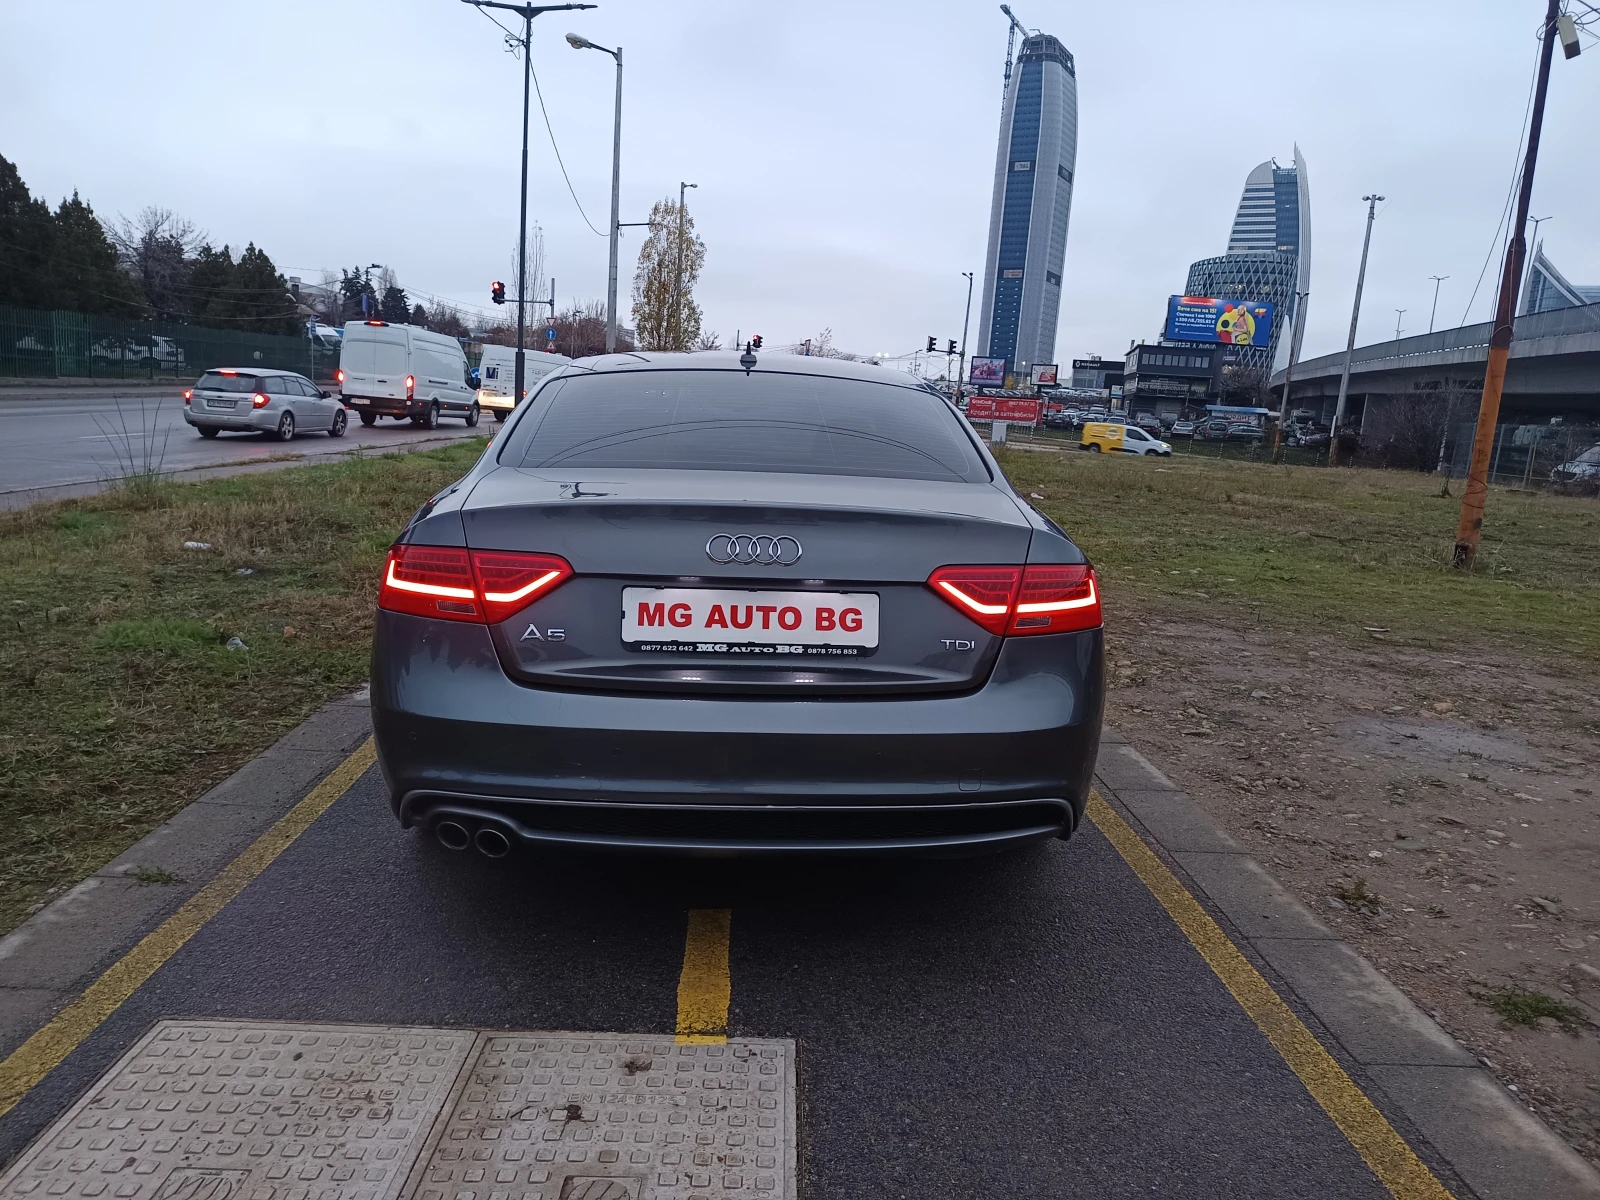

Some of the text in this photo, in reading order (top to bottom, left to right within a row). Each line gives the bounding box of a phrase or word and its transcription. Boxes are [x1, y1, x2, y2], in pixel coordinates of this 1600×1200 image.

[637, 602, 863, 632] MG AUTO BG
[519, 623, 566, 642] A5
[696, 643, 729, 652] MG
[775, 645, 805, 654] BG
[940, 639, 976, 650] TDI
[566, 1092, 594, 1103] EN
